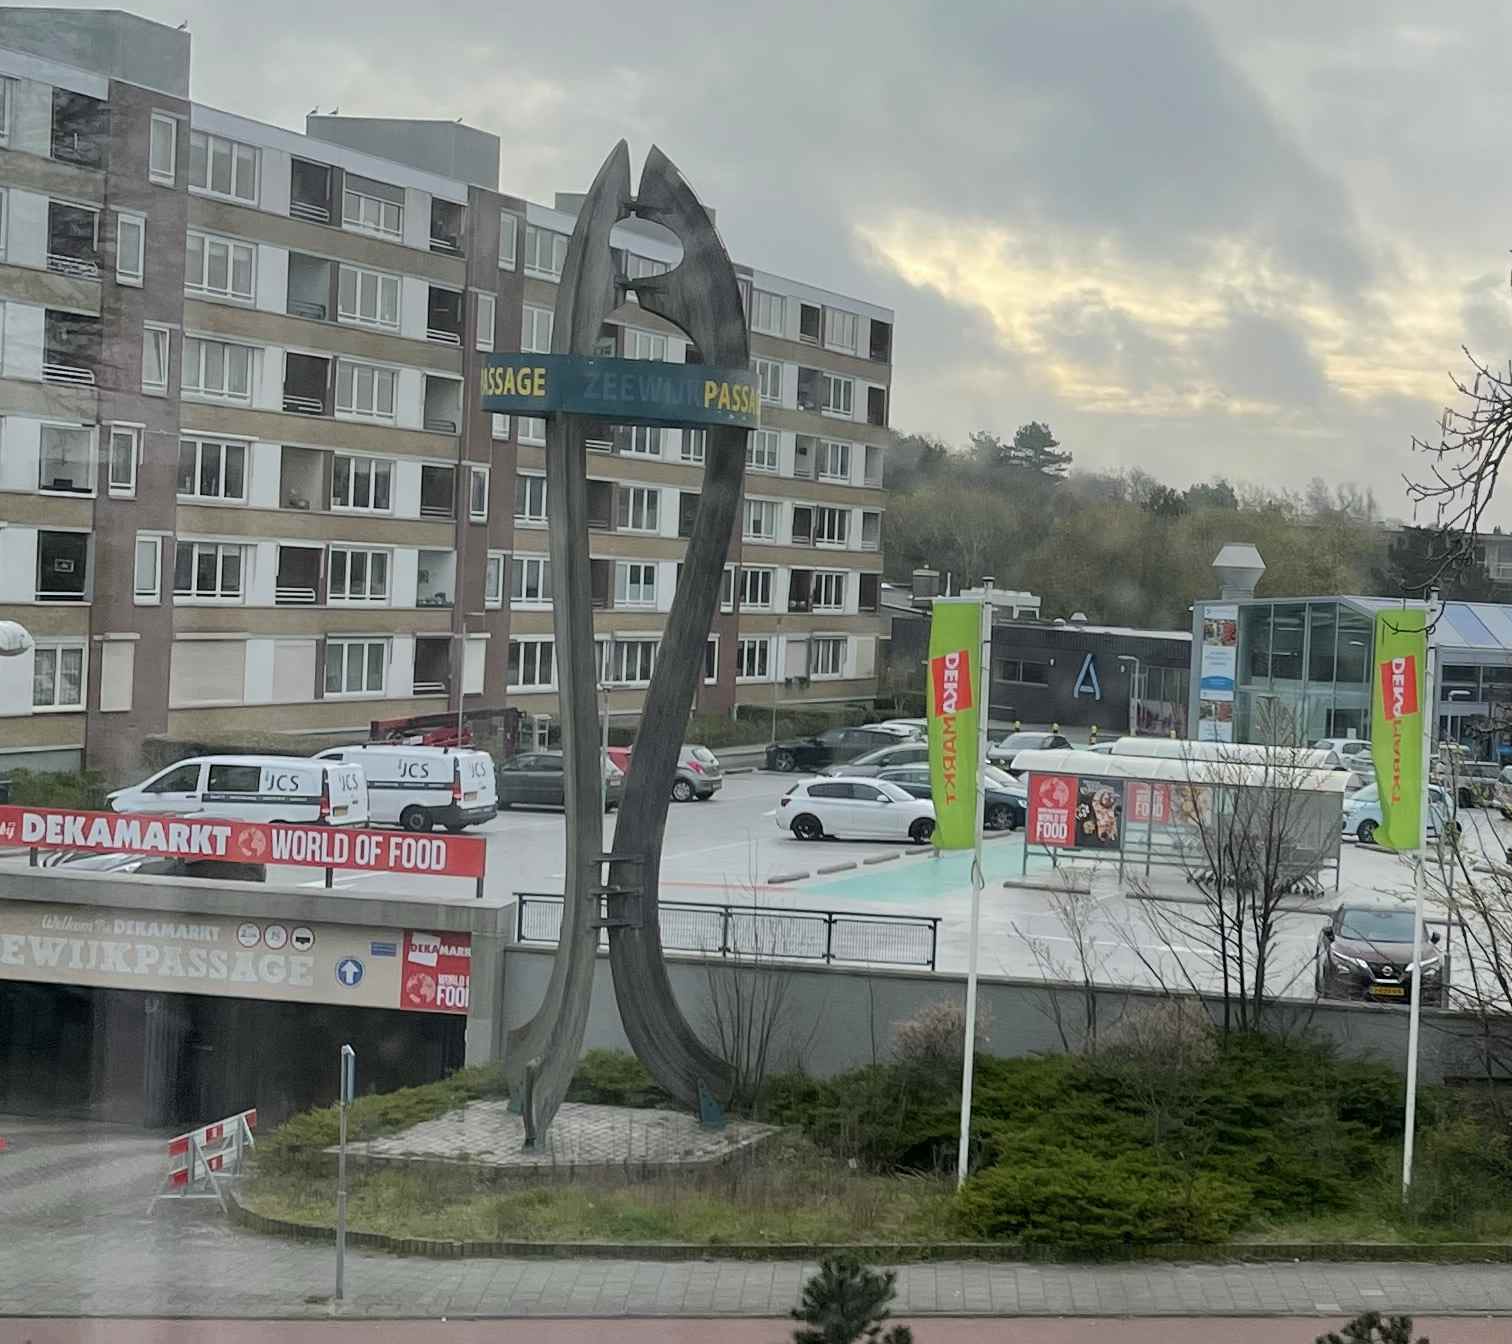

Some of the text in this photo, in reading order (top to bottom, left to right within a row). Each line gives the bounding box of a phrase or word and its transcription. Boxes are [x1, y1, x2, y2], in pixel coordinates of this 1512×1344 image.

[267, 774, 299, 792] JCS
[1036, 822, 1068, 840] FOOD
[21, 813, 232, 856] DEKAMARKT
[271, 828, 350, 864] WORLD
[354, 834, 384, 866] OF
[388, 837, 447, 871] FOOD
